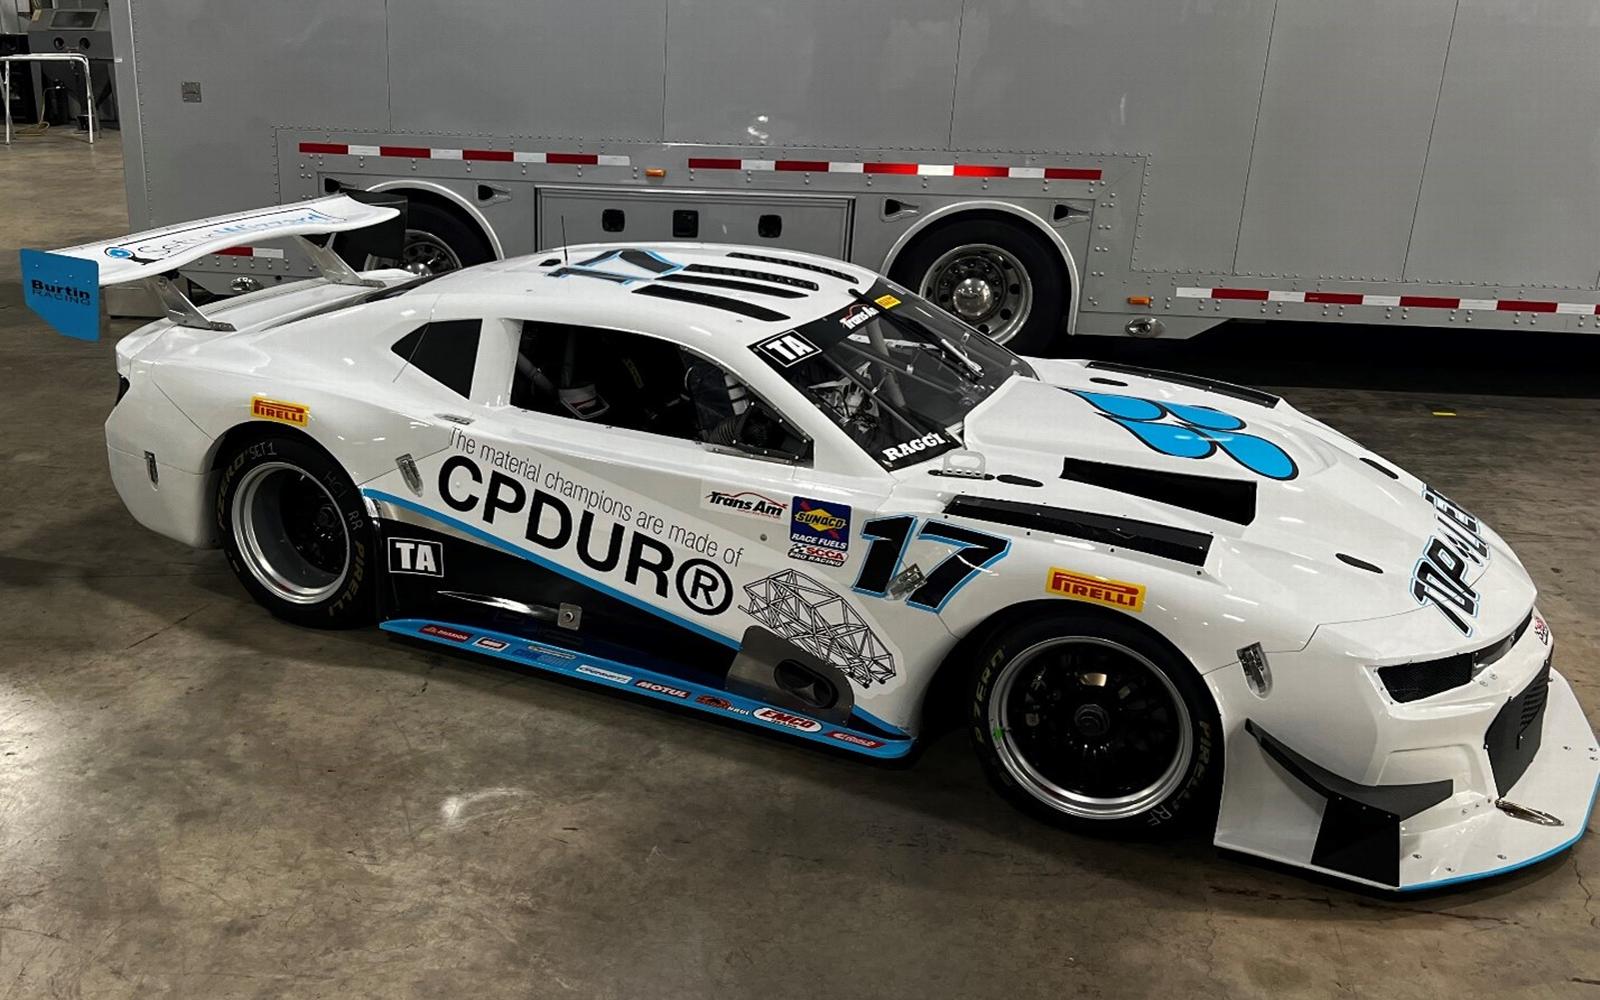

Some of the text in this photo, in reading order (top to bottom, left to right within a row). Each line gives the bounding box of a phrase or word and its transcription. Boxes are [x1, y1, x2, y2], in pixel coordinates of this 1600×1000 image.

[31, 278, 90, 299] Burtin
[31, 288, 90, 306] RACING
[765, 335, 814, 361] TA
[253, 399, 305, 423] PIRELLI
[882, 432, 946, 462] RAGGI
[449, 427, 746, 568] The material champions are made of
[709, 491, 752, 511] Trans
[752, 501, 783, 517] Am
[795, 512, 847, 530] SUNOCO
[791, 533, 848, 550] RACE FUELS
[806, 546, 844, 561] SCCA
[395, 542, 437, 573] TA
[789, 551, 842, 567] PRO RACING
[852, 515, 1013, 614] 17
[329, 540, 366, 616] PIRELLI
[1052, 571, 1140, 607] PIRELLI
[1410, 535, 1480, 638] TOP
[636, 680, 689, 698] MOTUL
[759, 709, 817, 729] EMCO
